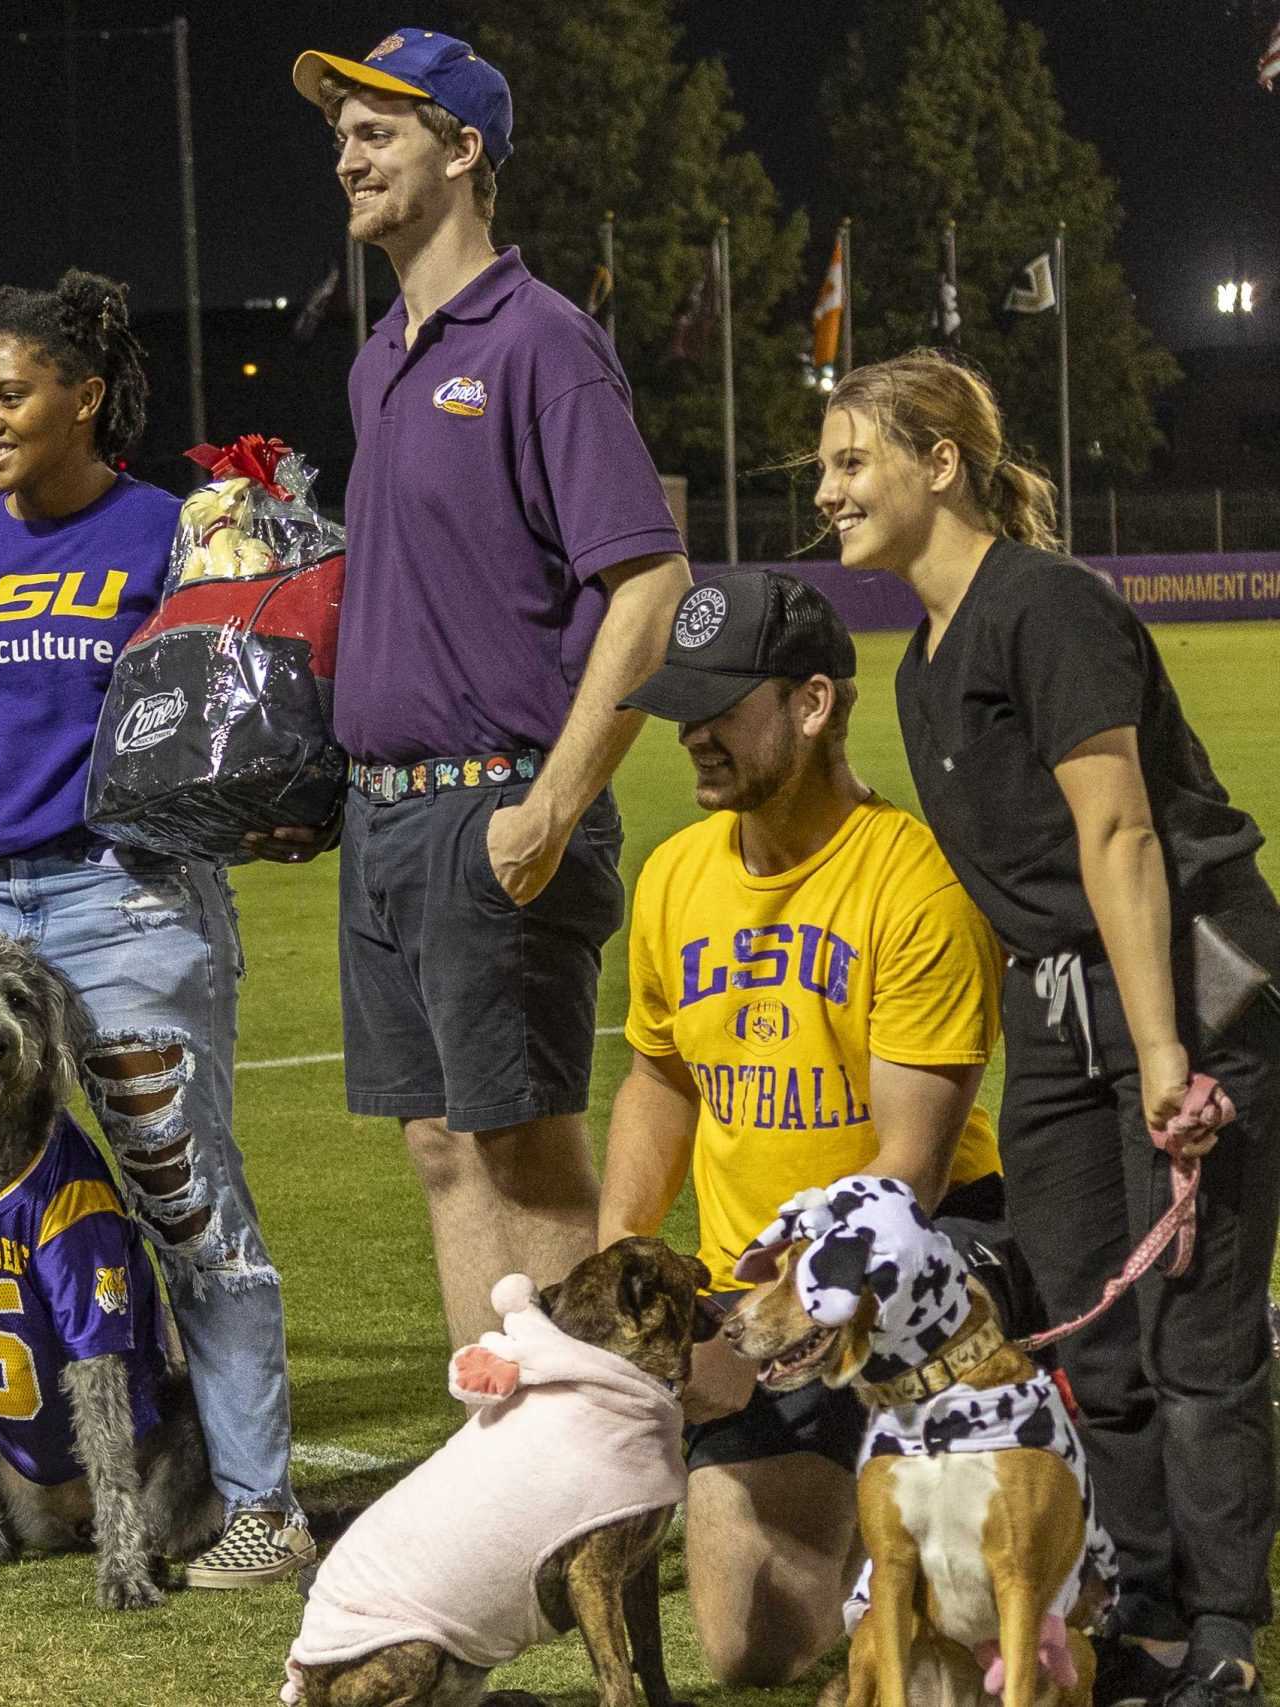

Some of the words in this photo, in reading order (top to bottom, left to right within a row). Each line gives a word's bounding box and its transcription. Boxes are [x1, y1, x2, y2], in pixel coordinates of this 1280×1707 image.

[690, 591, 724, 612] STORAGE
[1122, 573, 1247, 604] TOURNAMENT
[117, 688, 187, 751] Cane's
[679, 924, 860, 1009] LSU
[685, 1061, 871, 1131] OOTBALL
